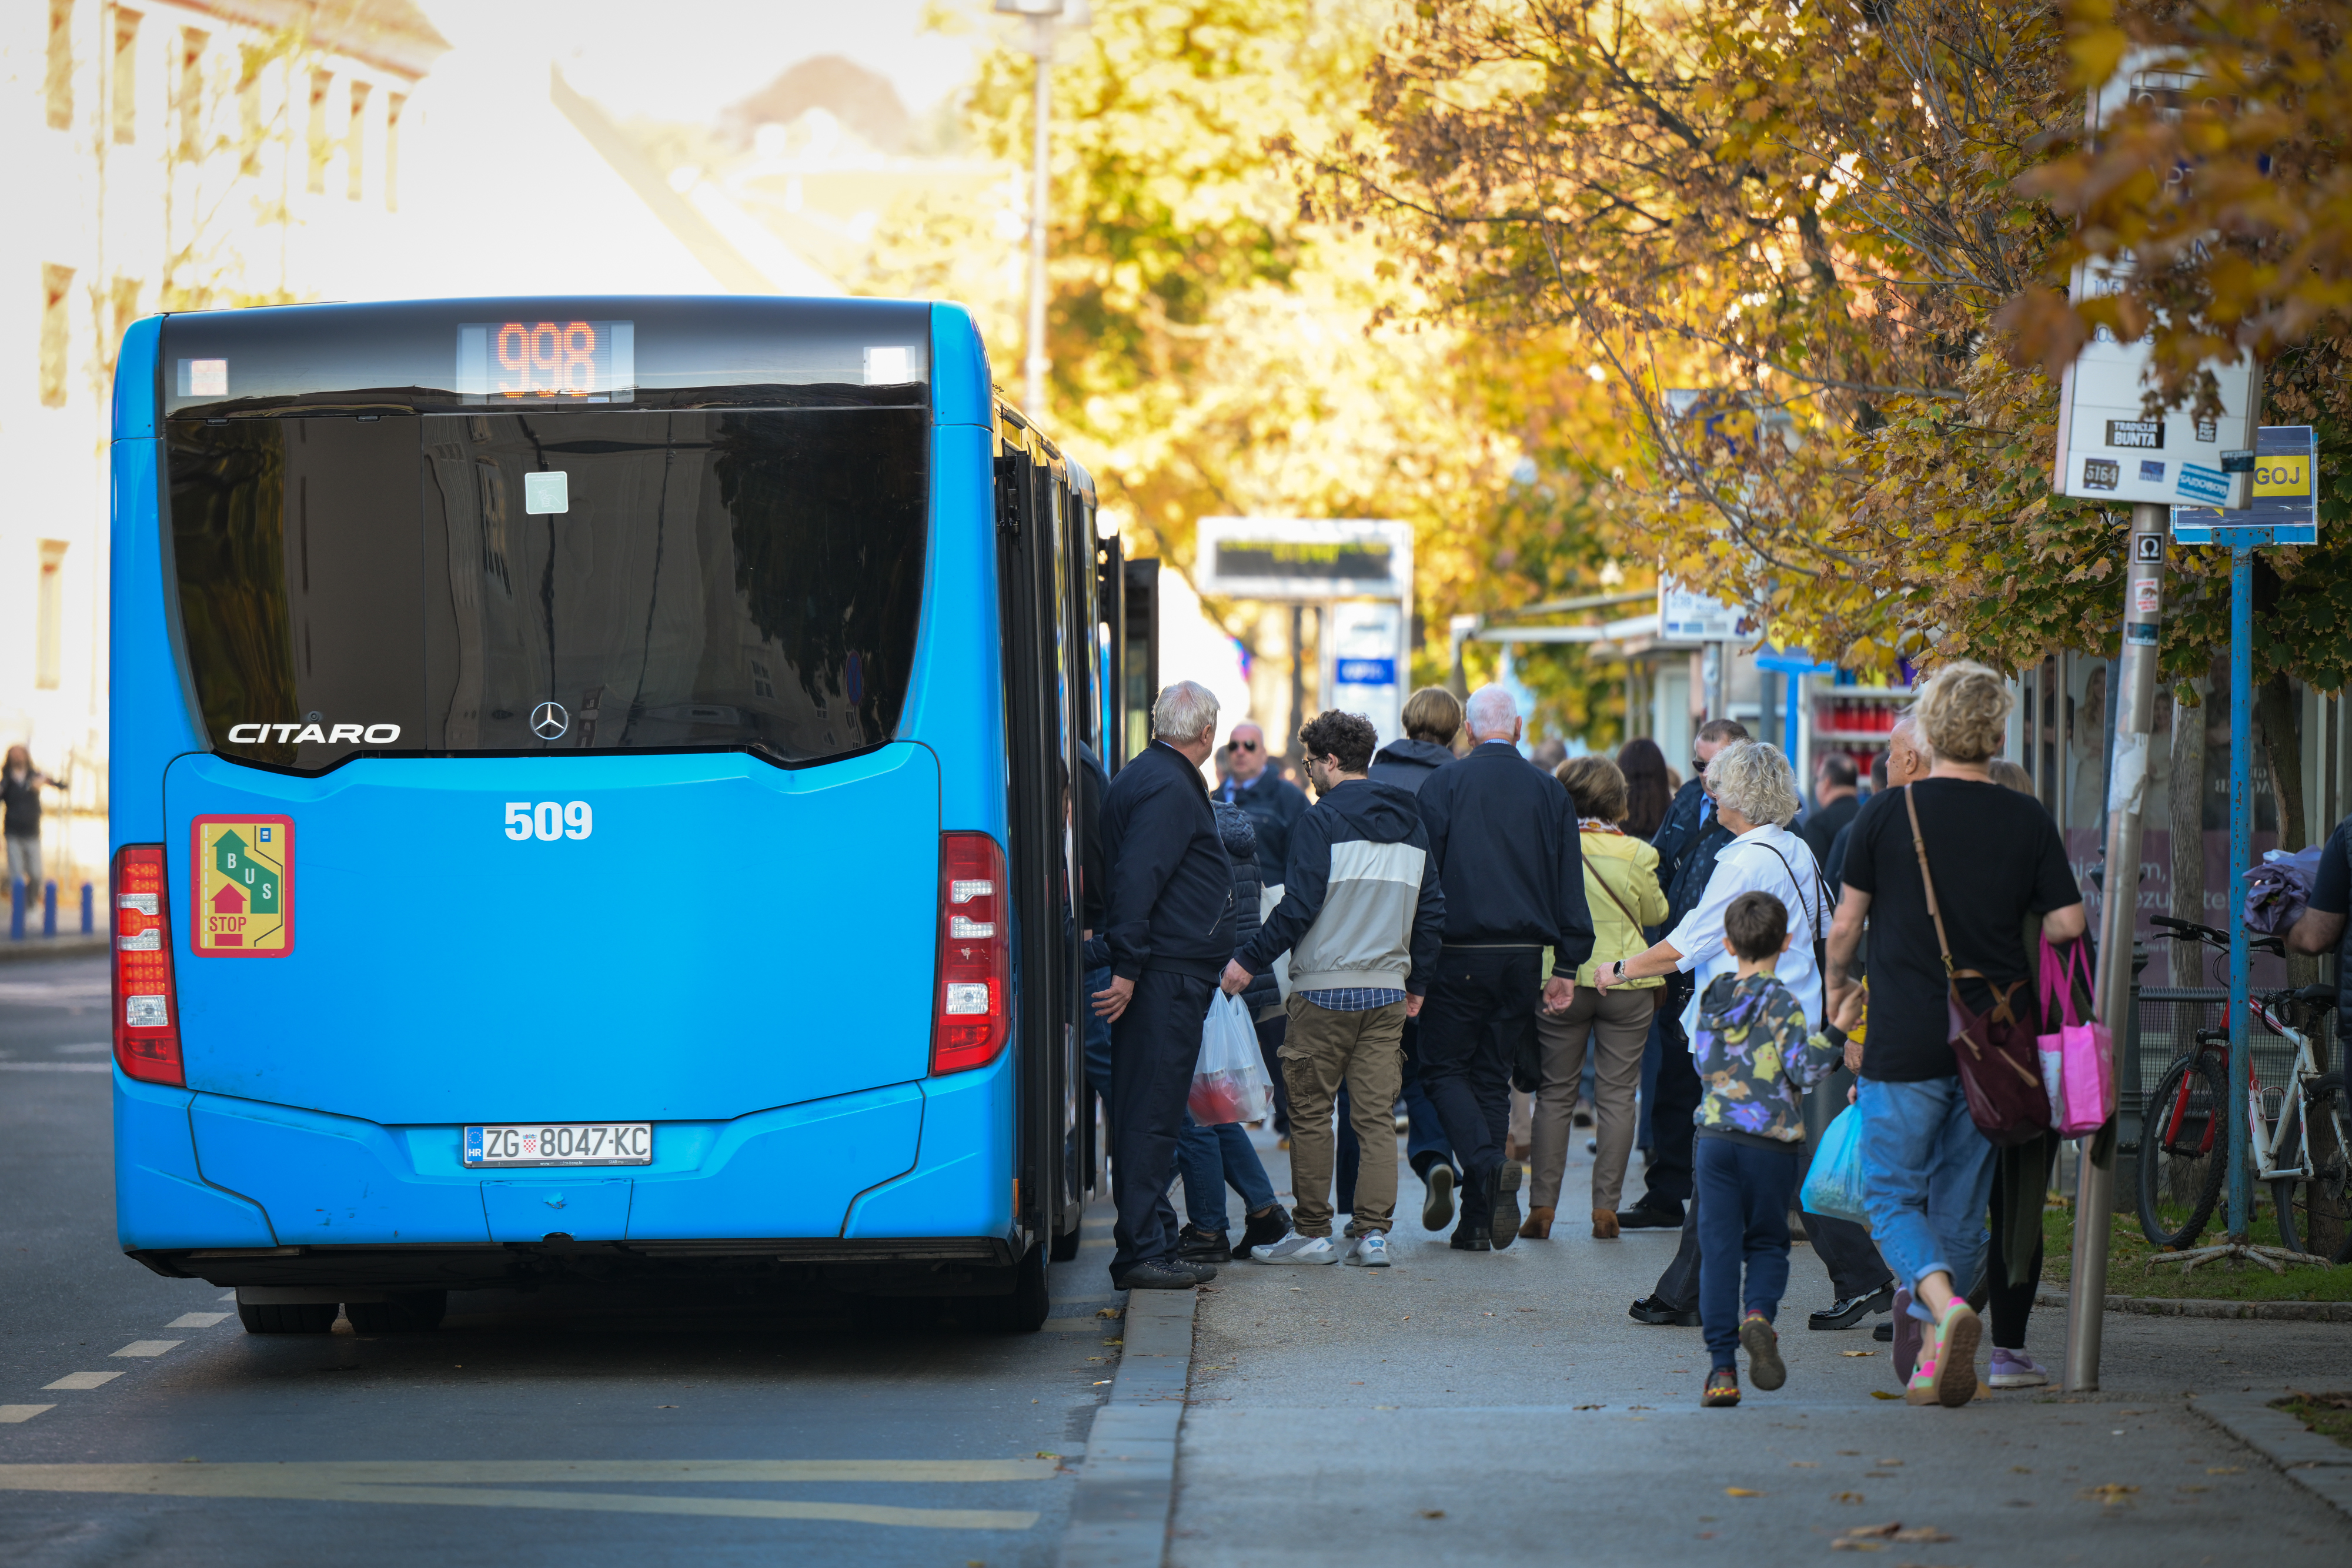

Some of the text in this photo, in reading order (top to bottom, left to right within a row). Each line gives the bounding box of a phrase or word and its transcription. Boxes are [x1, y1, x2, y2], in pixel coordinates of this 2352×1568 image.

[499, 322, 594, 398] 998
[2113, 432, 2157, 447] BUNTA
[2253, 466, 2300, 485] GOJ
[228, 724, 401, 743] CITARO
[505, 801, 593, 841] 509
[209, 916, 247, 932] STOP
[486, 1129, 519, 1158] ZG
